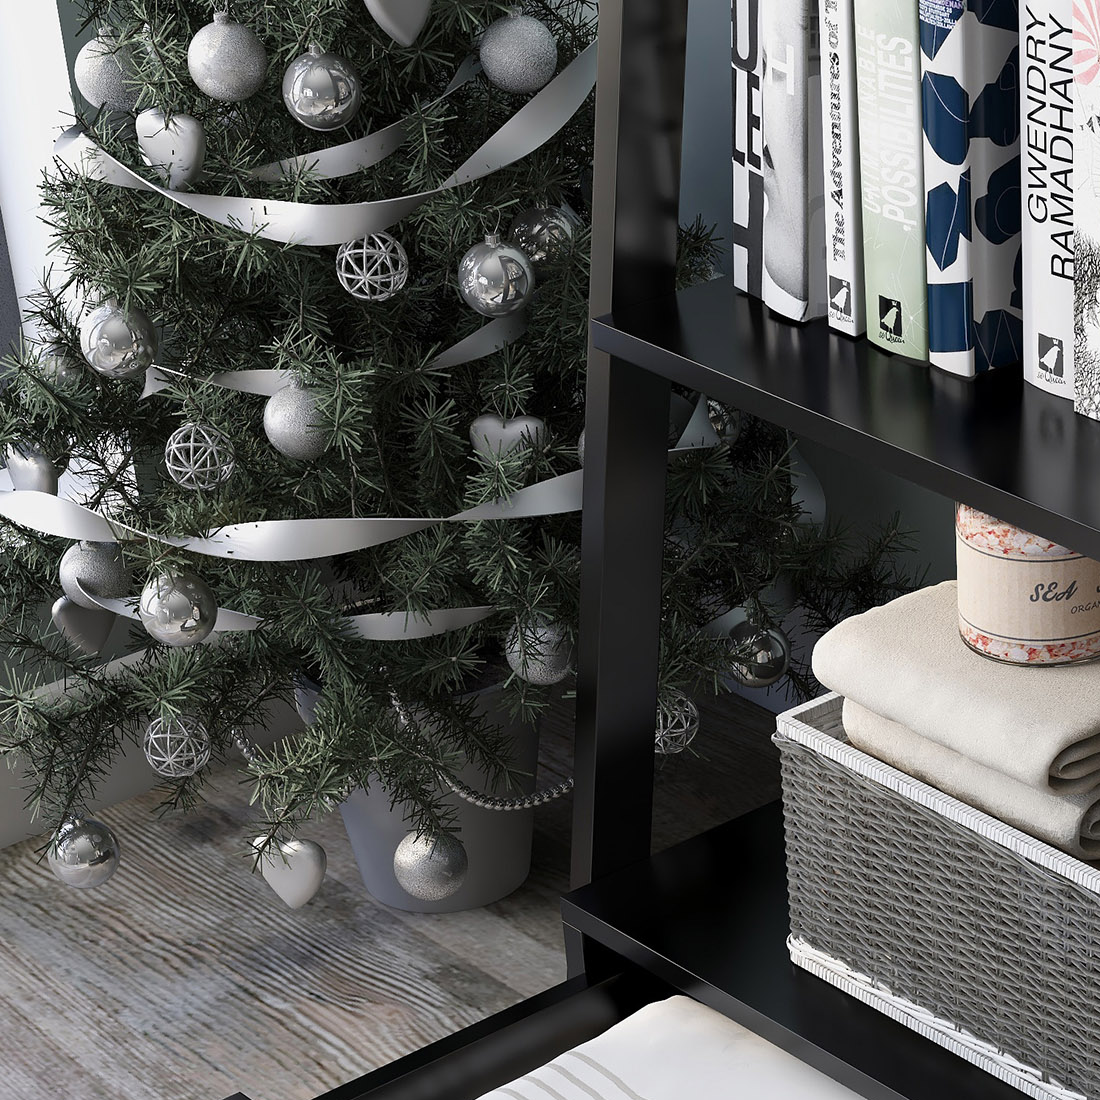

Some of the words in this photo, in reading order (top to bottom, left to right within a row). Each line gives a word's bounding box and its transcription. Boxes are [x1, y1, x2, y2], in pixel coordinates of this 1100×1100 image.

[829, 52, 844, 209] Adventures
[876, 34, 917, 227] POSSIBILITIES
[1026, 5, 1049, 224] GWENDRY
[1049, 13, 1074, 282] RAMADHANY
[832, 211, 846, 262] The
[1030, 580, 1078, 602] SEA
